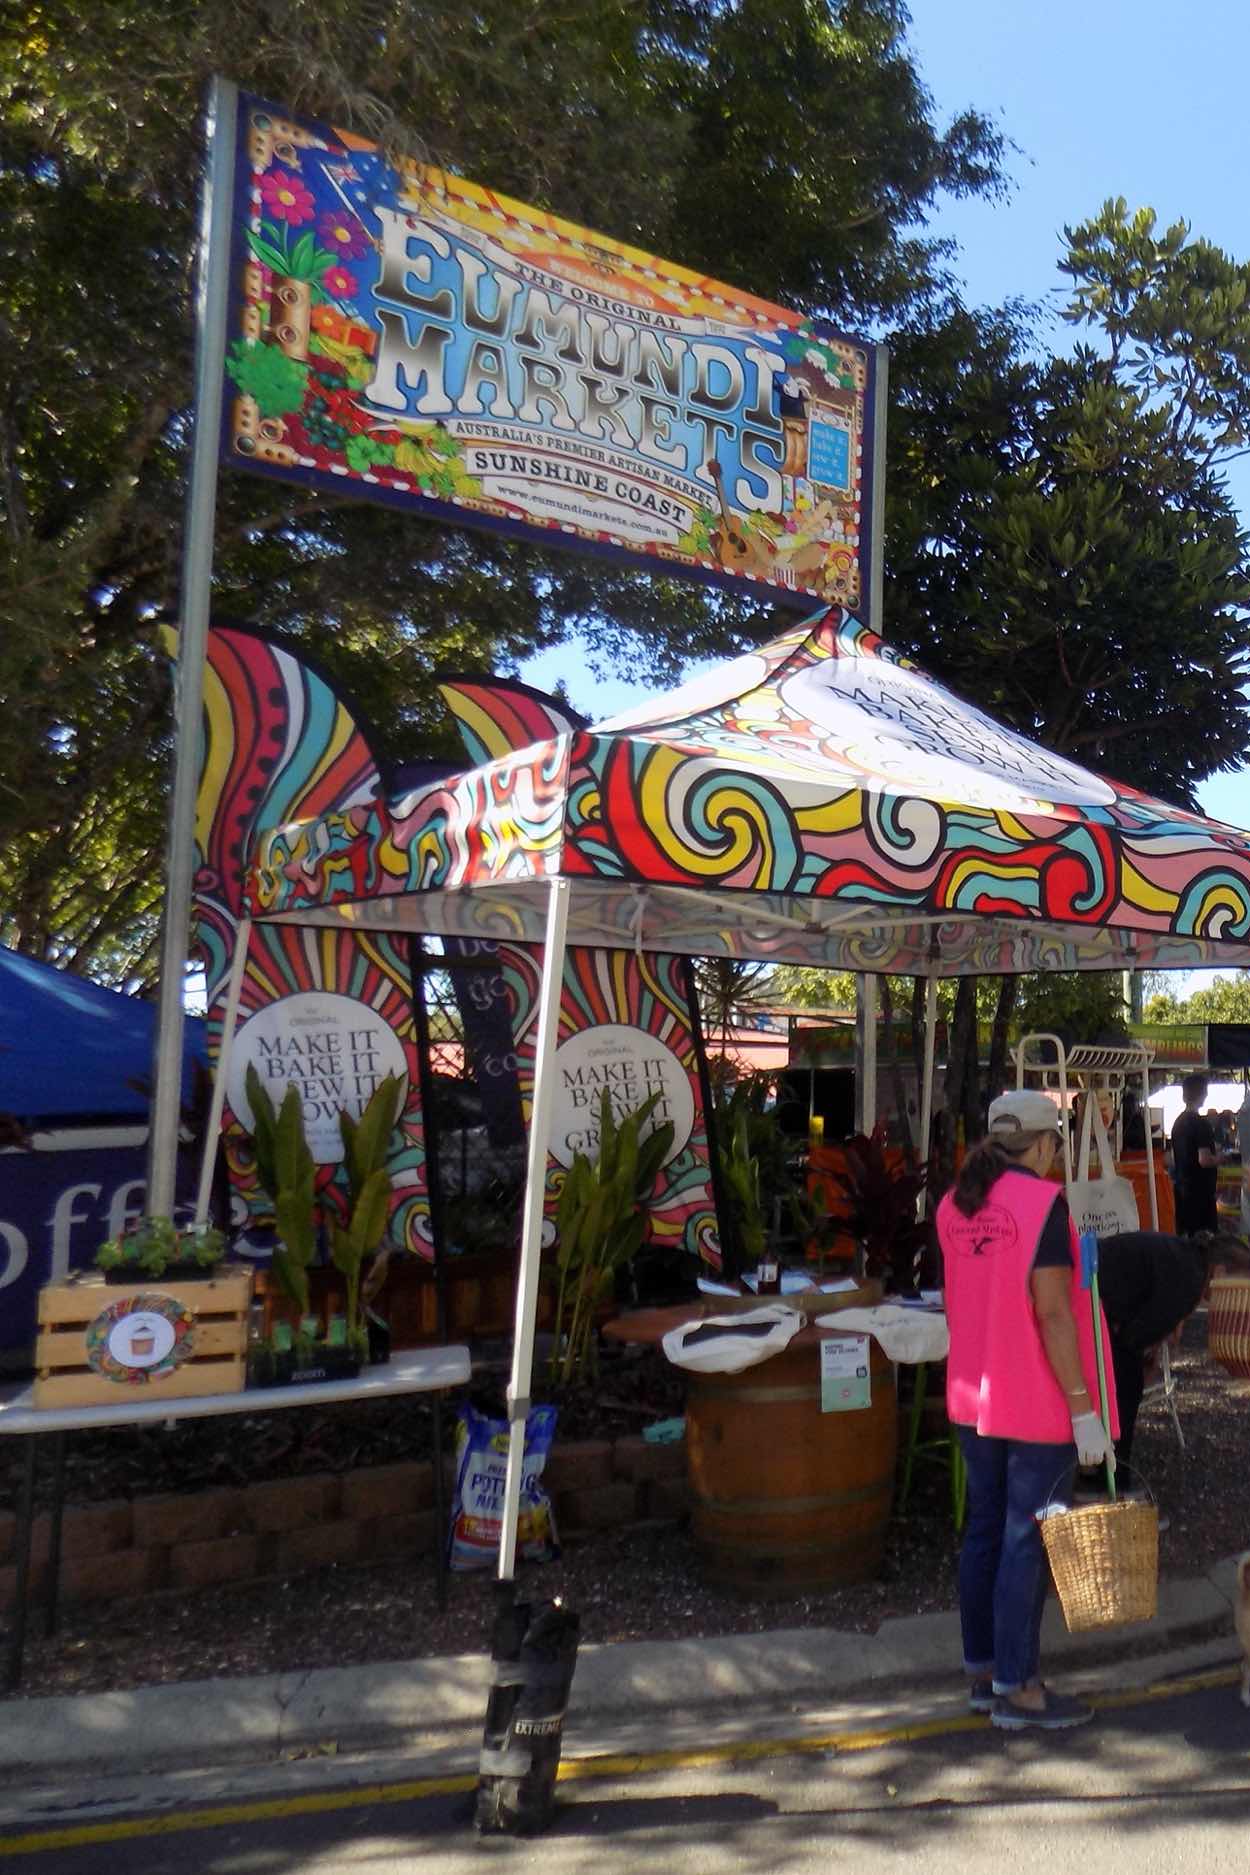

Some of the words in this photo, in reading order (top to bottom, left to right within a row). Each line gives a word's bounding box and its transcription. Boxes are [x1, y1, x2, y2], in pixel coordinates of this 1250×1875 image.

[371, 206, 787, 434] EUMUNDI
[513, 262, 564, 292] THE
[571, 287, 681, 332] ORIGINAL
[365, 308, 786, 514] MARKETS
[456, 421, 544, 447] AUSTRALIA'S
[547, 437, 607, 462] PREMIER
[608, 455, 660, 482] ARTISAN
[662, 475, 714, 507] MARKET
[474, 451, 609, 494] SUNSHINE
[615, 481, 687, 526] COAST
[497, 484, 669, 539] www.eumundimarkets.com.au
[825, 684, 961, 722] MAKE
[855, 702, 981, 738] BAKE
[994, 731, 1036, 754] IT
[904, 724, 1003, 756] SEW
[1014, 747, 1061, 772] IT
[1038, 766, 1084, 787] IT
[257, 1032, 342, 1057] MAKE
[349, 1030, 378, 1051] IT
[266, 1054, 344, 1079] BAKE
[352, 1052, 381, 1074] IT
[561, 1062, 638, 1089] MAKE
[641, 1059, 667, 1078] IT
[570, 1081, 641, 1108] BAKE
[646, 1079, 669, 1098] IT
[589, 1102, 640, 1127] SW
